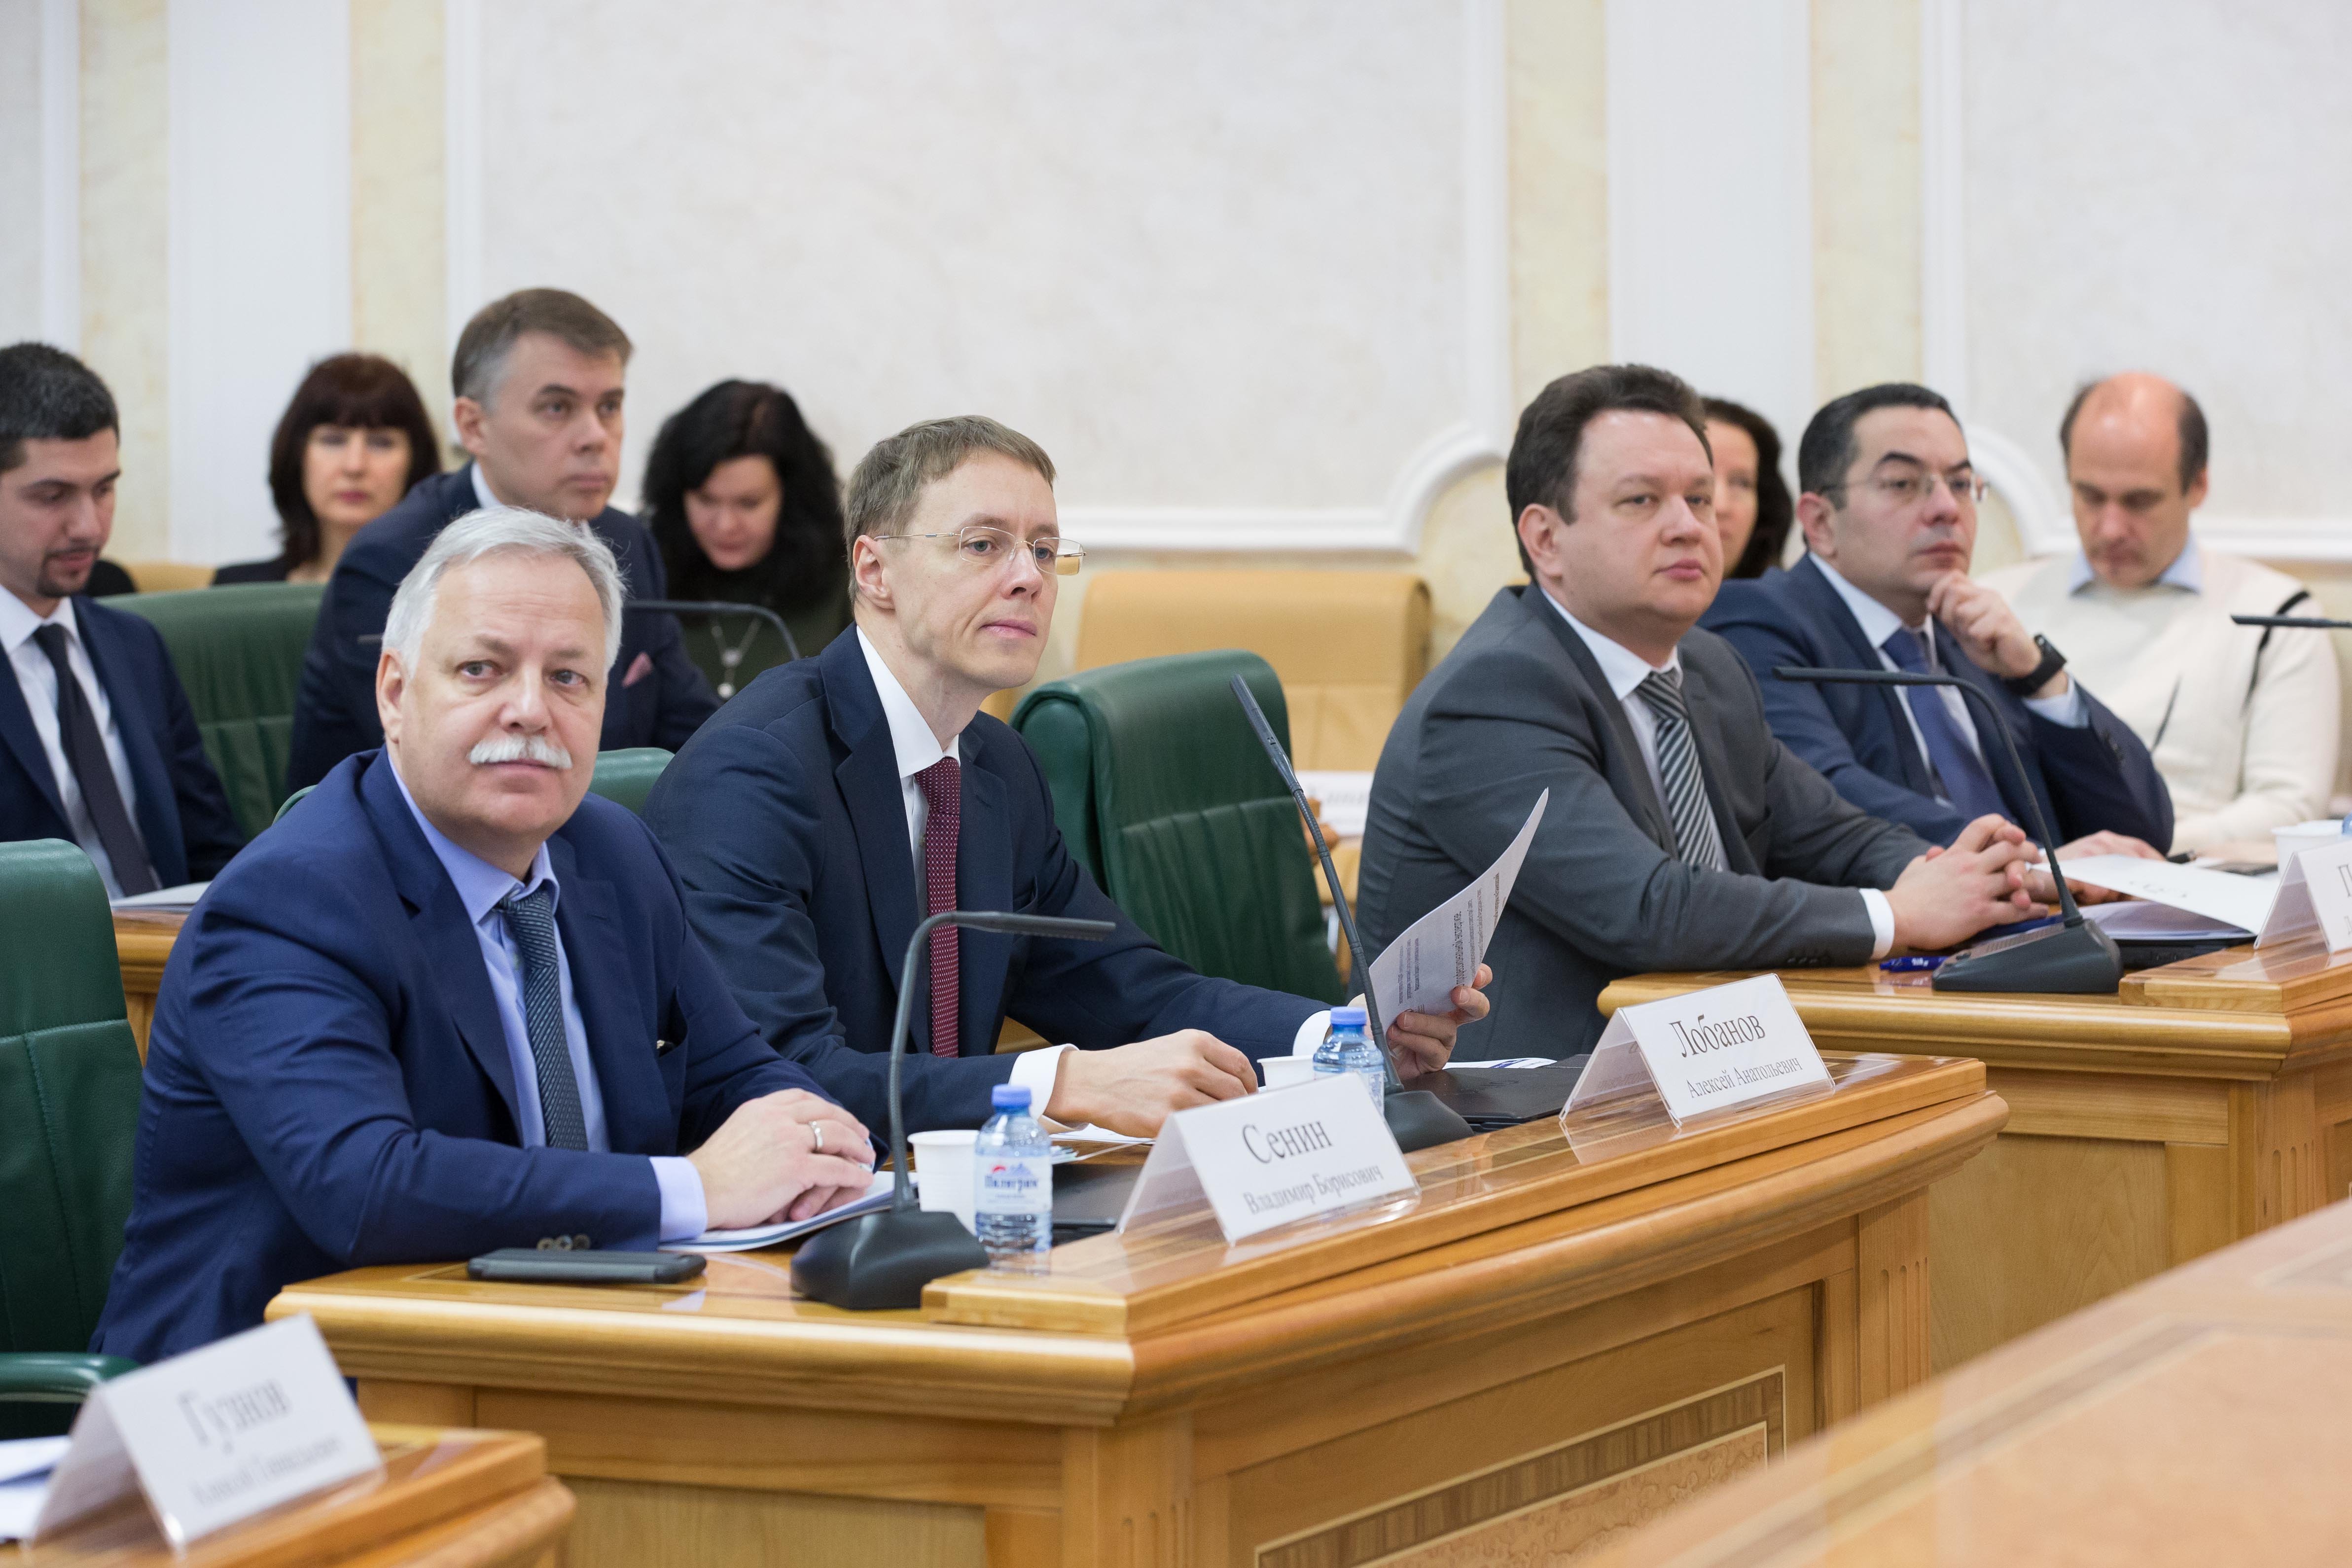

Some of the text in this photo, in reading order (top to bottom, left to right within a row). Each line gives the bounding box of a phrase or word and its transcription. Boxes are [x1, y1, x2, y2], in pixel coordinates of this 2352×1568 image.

[1669, 1014, 1765, 1058] Лобанов
[1686, 1058, 1803, 1098] Алексей Анатольевич
[1242, 1121, 1333, 1164] Сенин
[1242, 1165, 1384, 1214] Владимир Борисович
